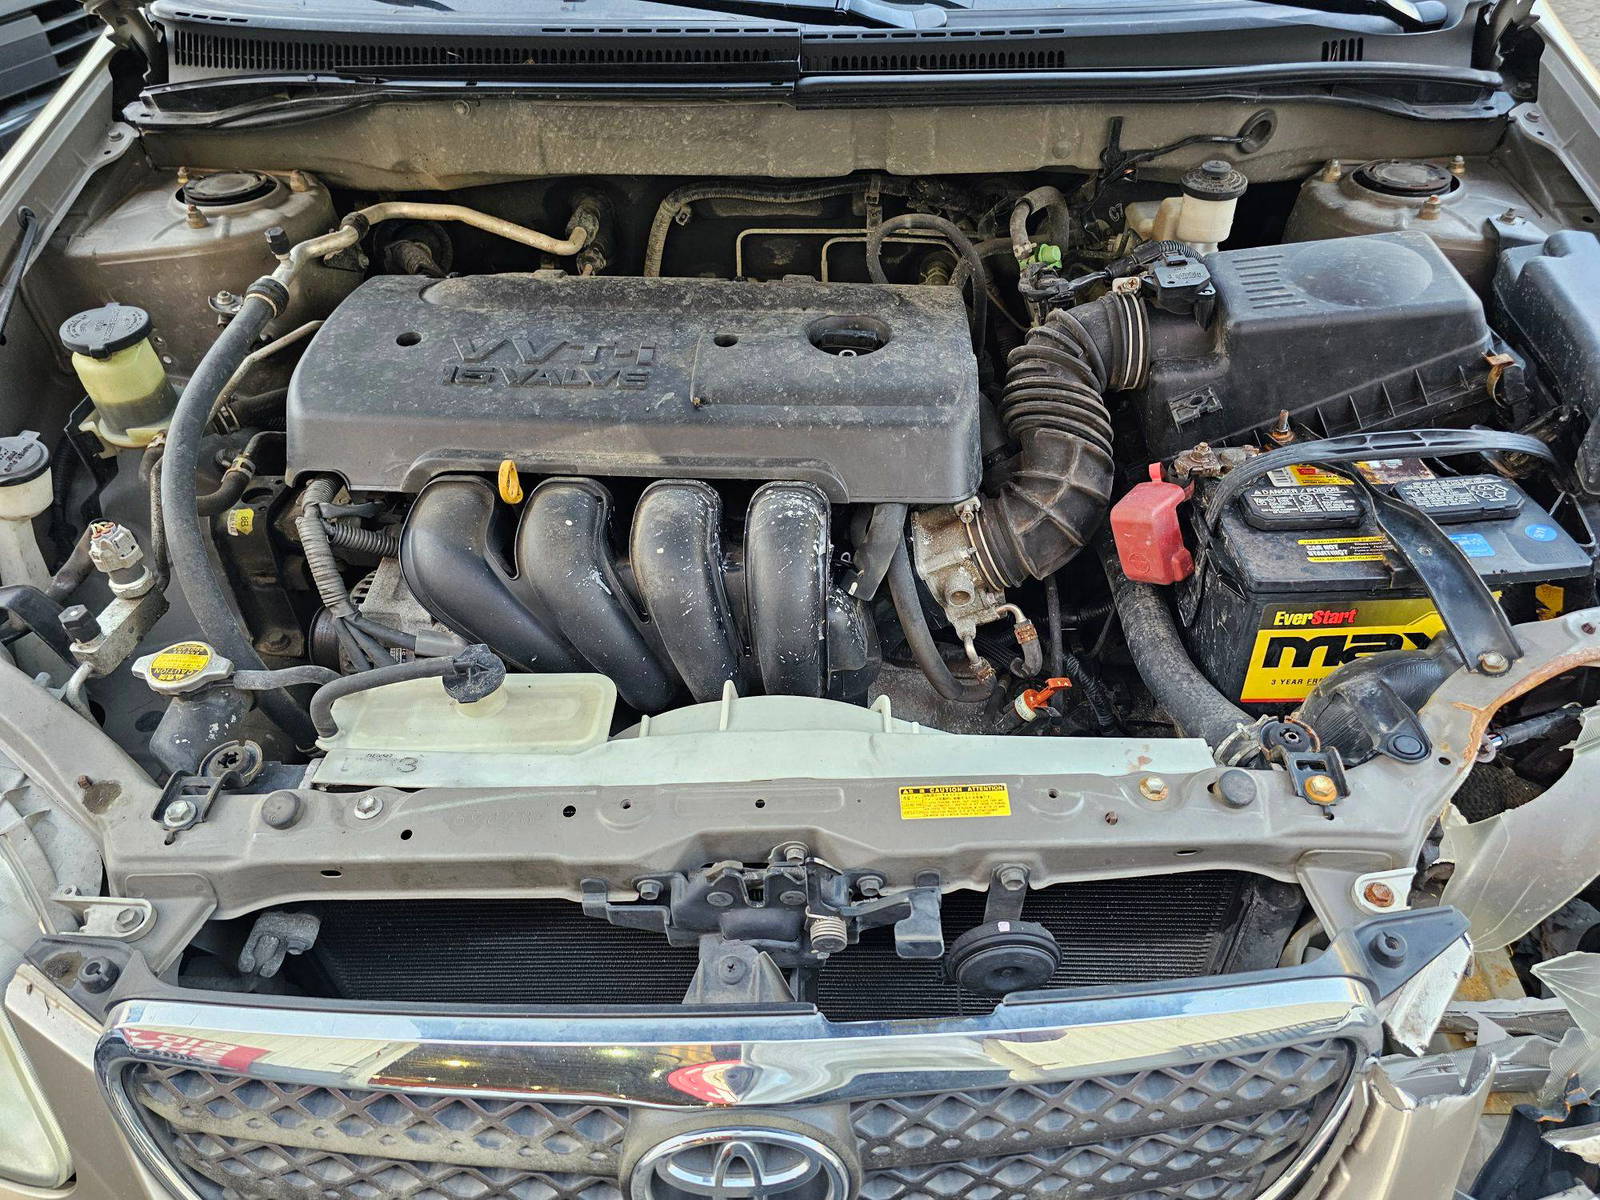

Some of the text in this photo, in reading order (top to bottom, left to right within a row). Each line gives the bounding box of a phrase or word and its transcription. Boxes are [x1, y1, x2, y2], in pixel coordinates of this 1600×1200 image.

[500, 367, 650, 390] VALVE
[1273, 608, 1359, 626] EverStart
[154, 667, 193, 675] CAUTION
[967, 784, 1004, 792] ATTENTION
